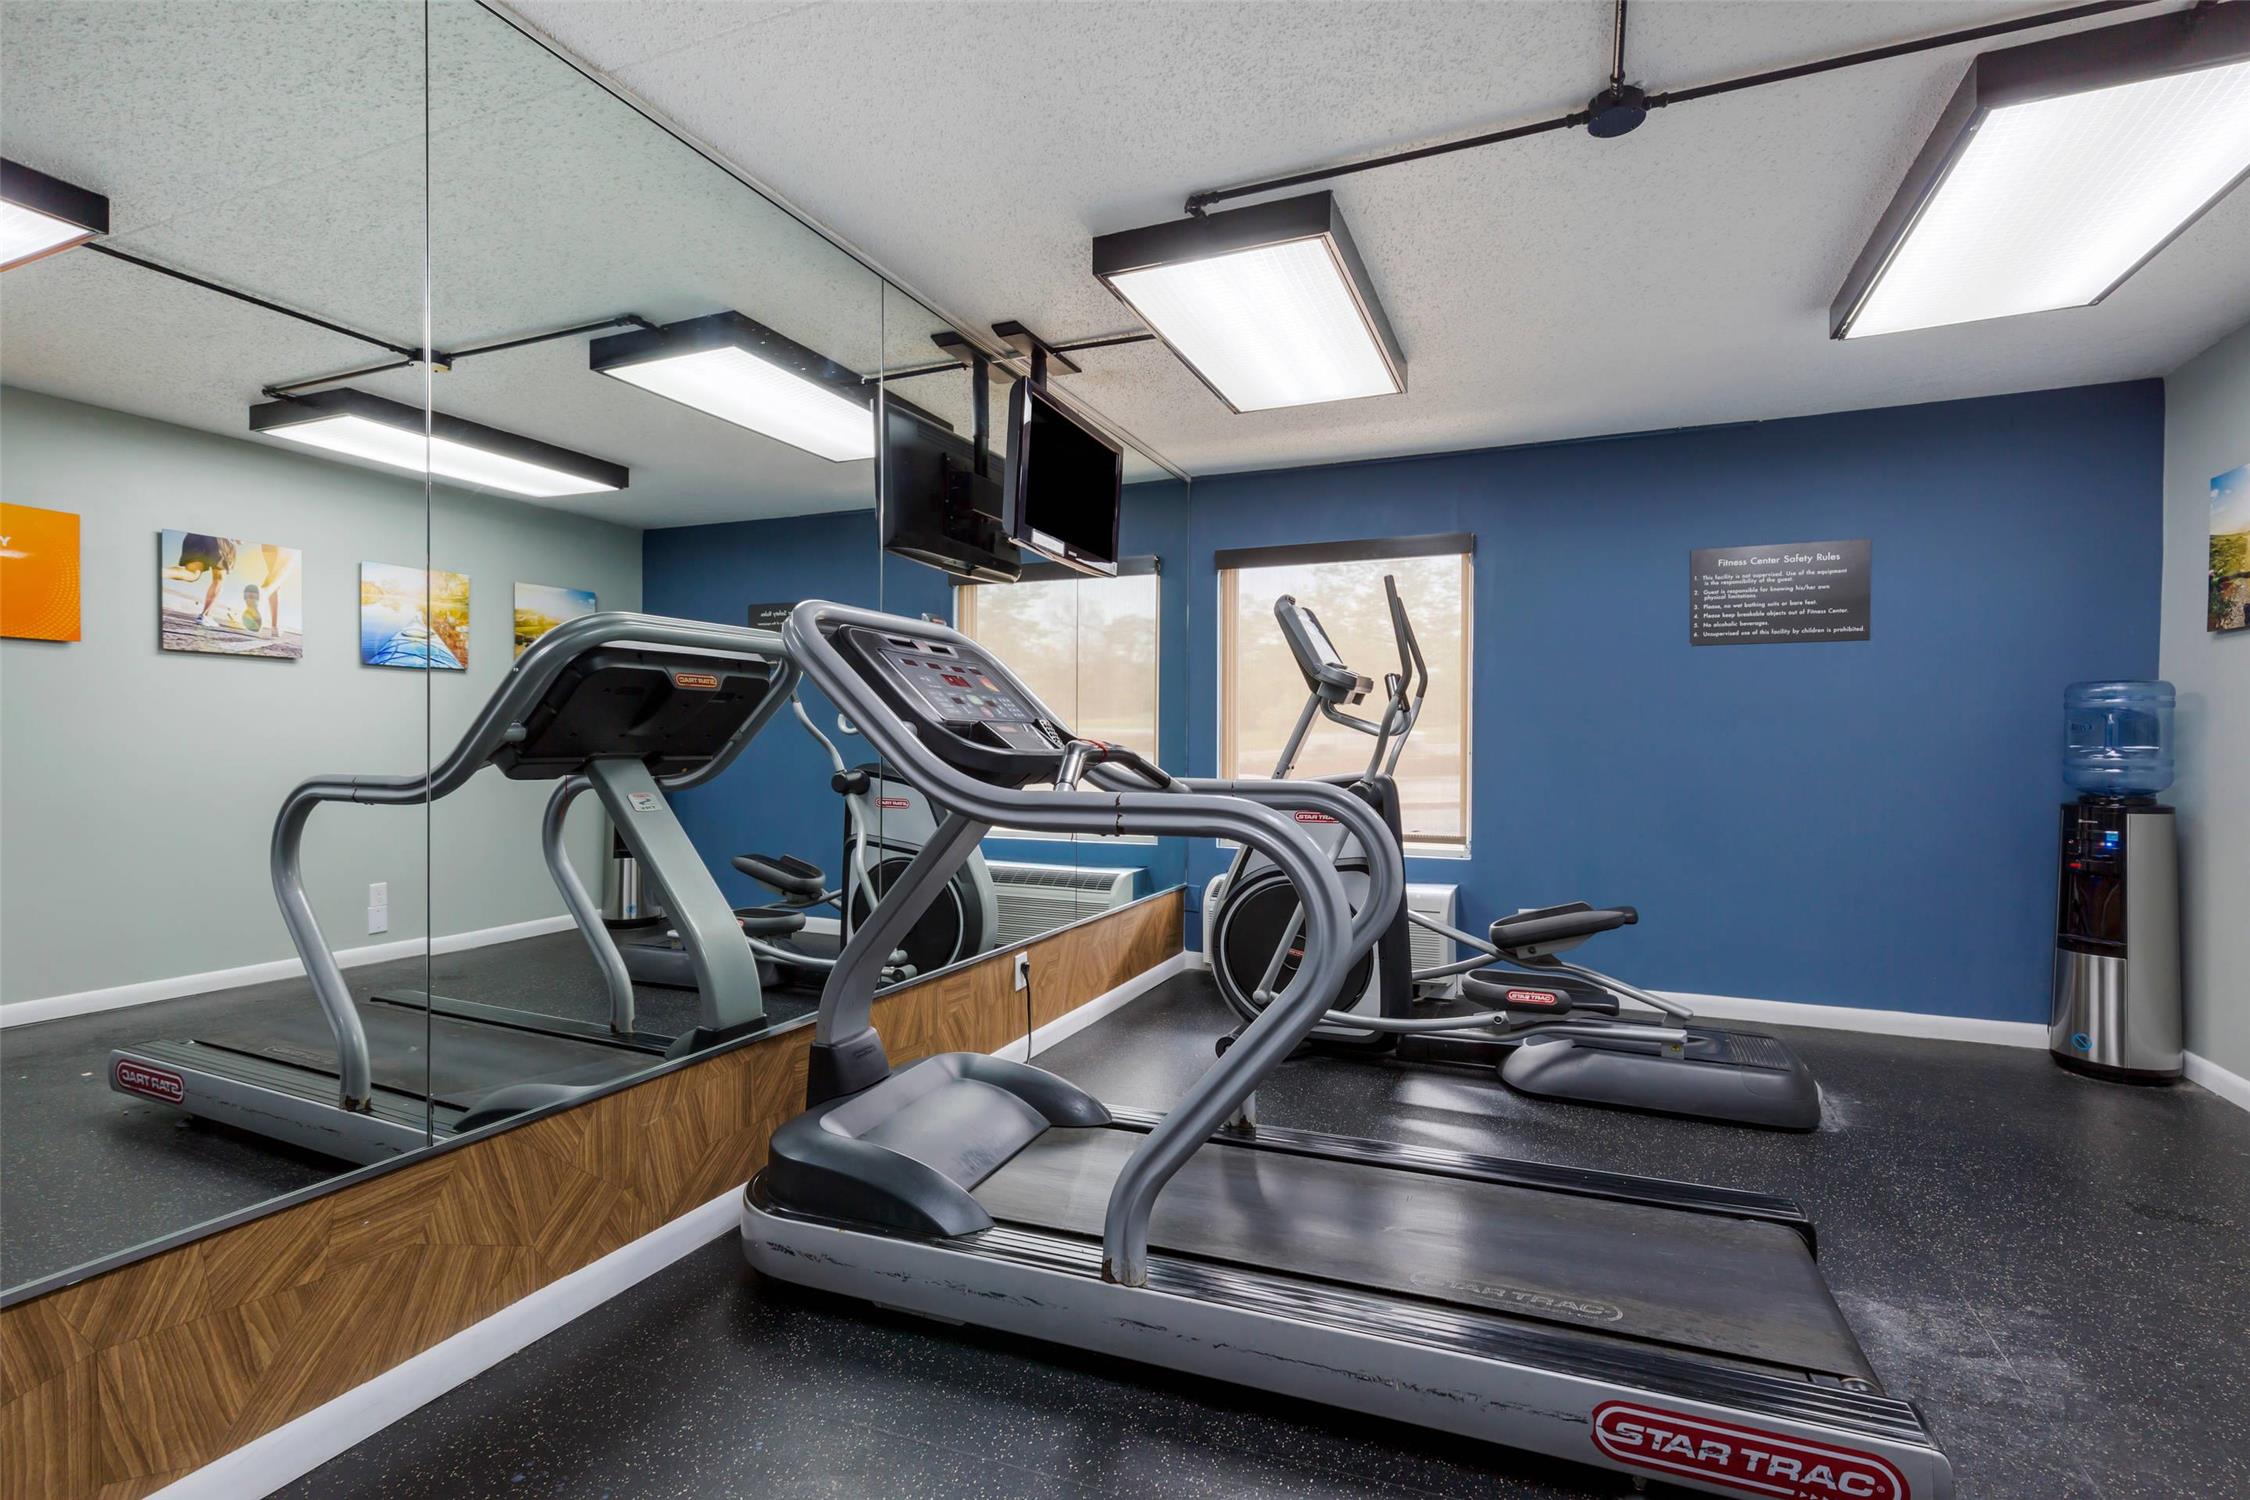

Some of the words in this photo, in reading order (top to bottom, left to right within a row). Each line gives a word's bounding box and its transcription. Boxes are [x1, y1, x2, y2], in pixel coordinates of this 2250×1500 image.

[1784, 553, 1812, 563] Safety
[1817, 552, 1840, 560] Rules
[1512, 1290, 1605, 1314] TRAC
[1603, 1421, 1732, 1466] STAR
[1740, 1448, 1876, 1497] TRAC
